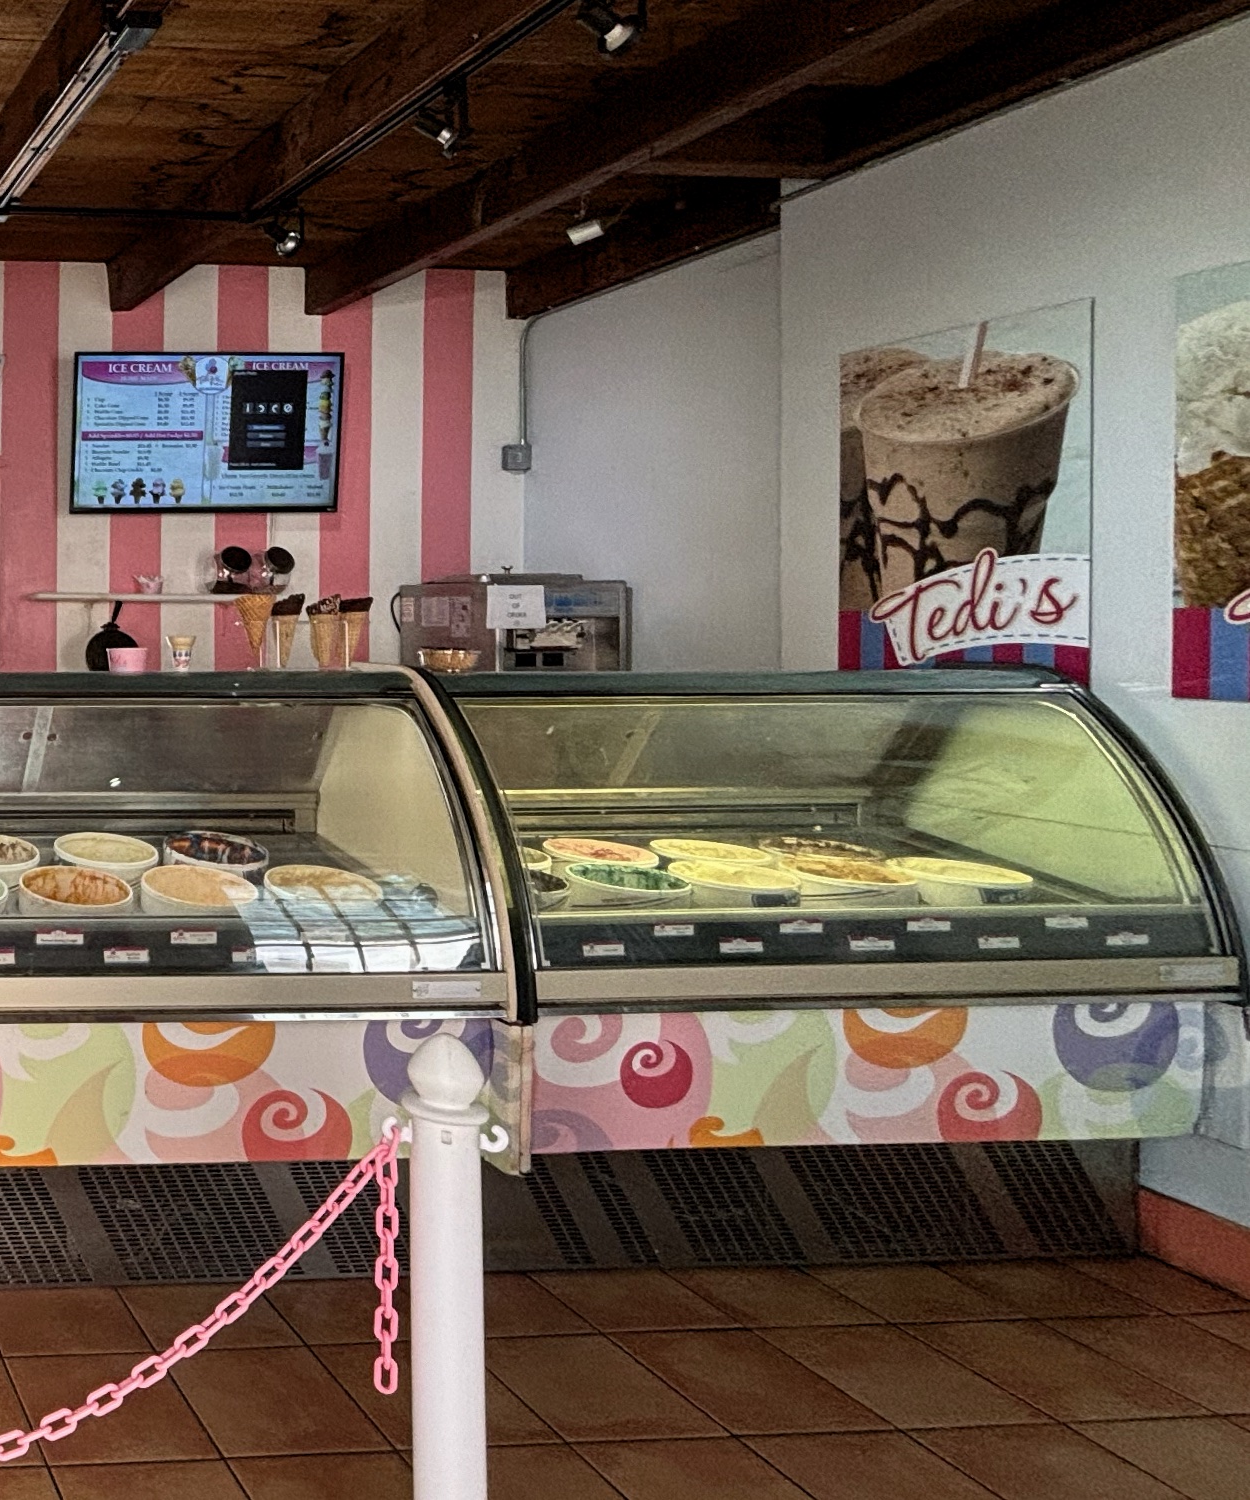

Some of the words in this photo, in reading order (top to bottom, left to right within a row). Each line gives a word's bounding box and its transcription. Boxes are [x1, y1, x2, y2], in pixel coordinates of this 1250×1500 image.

[108, 363, 128, 373] ICE
[130, 363, 172, 373] CREAM
[252, 362, 269, 370] ICE
[271, 362, 309, 370] CREAM
[872, 550, 1080, 661] Tedi's
